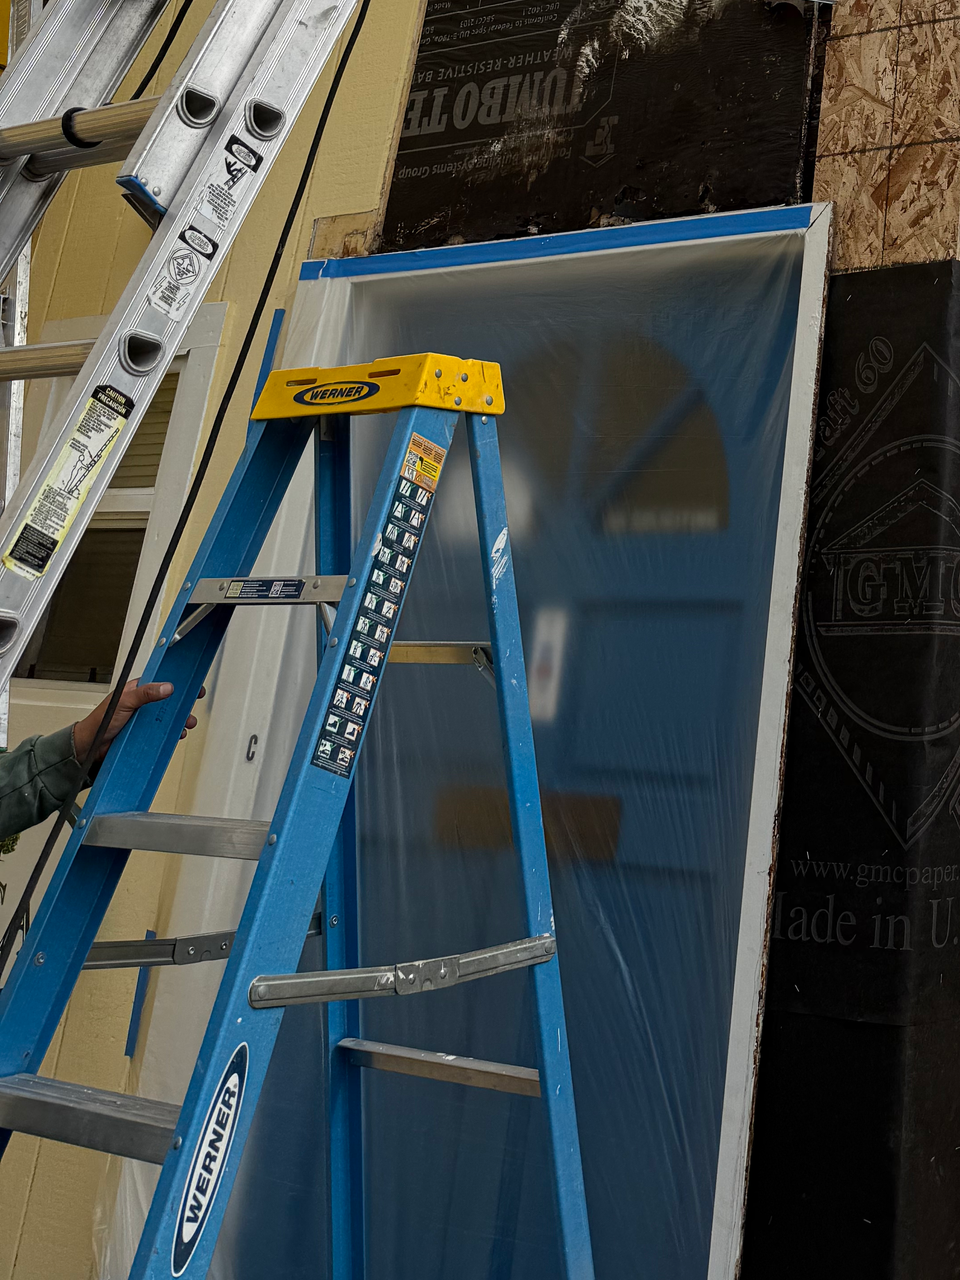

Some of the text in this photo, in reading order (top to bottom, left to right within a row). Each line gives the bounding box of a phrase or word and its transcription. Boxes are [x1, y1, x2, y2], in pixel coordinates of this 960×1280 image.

[488, 22, 513, 32] Federal
[524, 13, 558, 24] Conforms
[437, 49, 572, 80] WEATHER-RESISTIVE
[399, 86, 449, 138] TE
[398, 165, 430, 179] Group
[854, 336, 895, 394] 60
[104, 385, 127, 403] CAUTION
[309, 384, 365, 402] WERNER
[869, 896, 915, 951] in
[183, 1081, 240, 1227] WERNER
